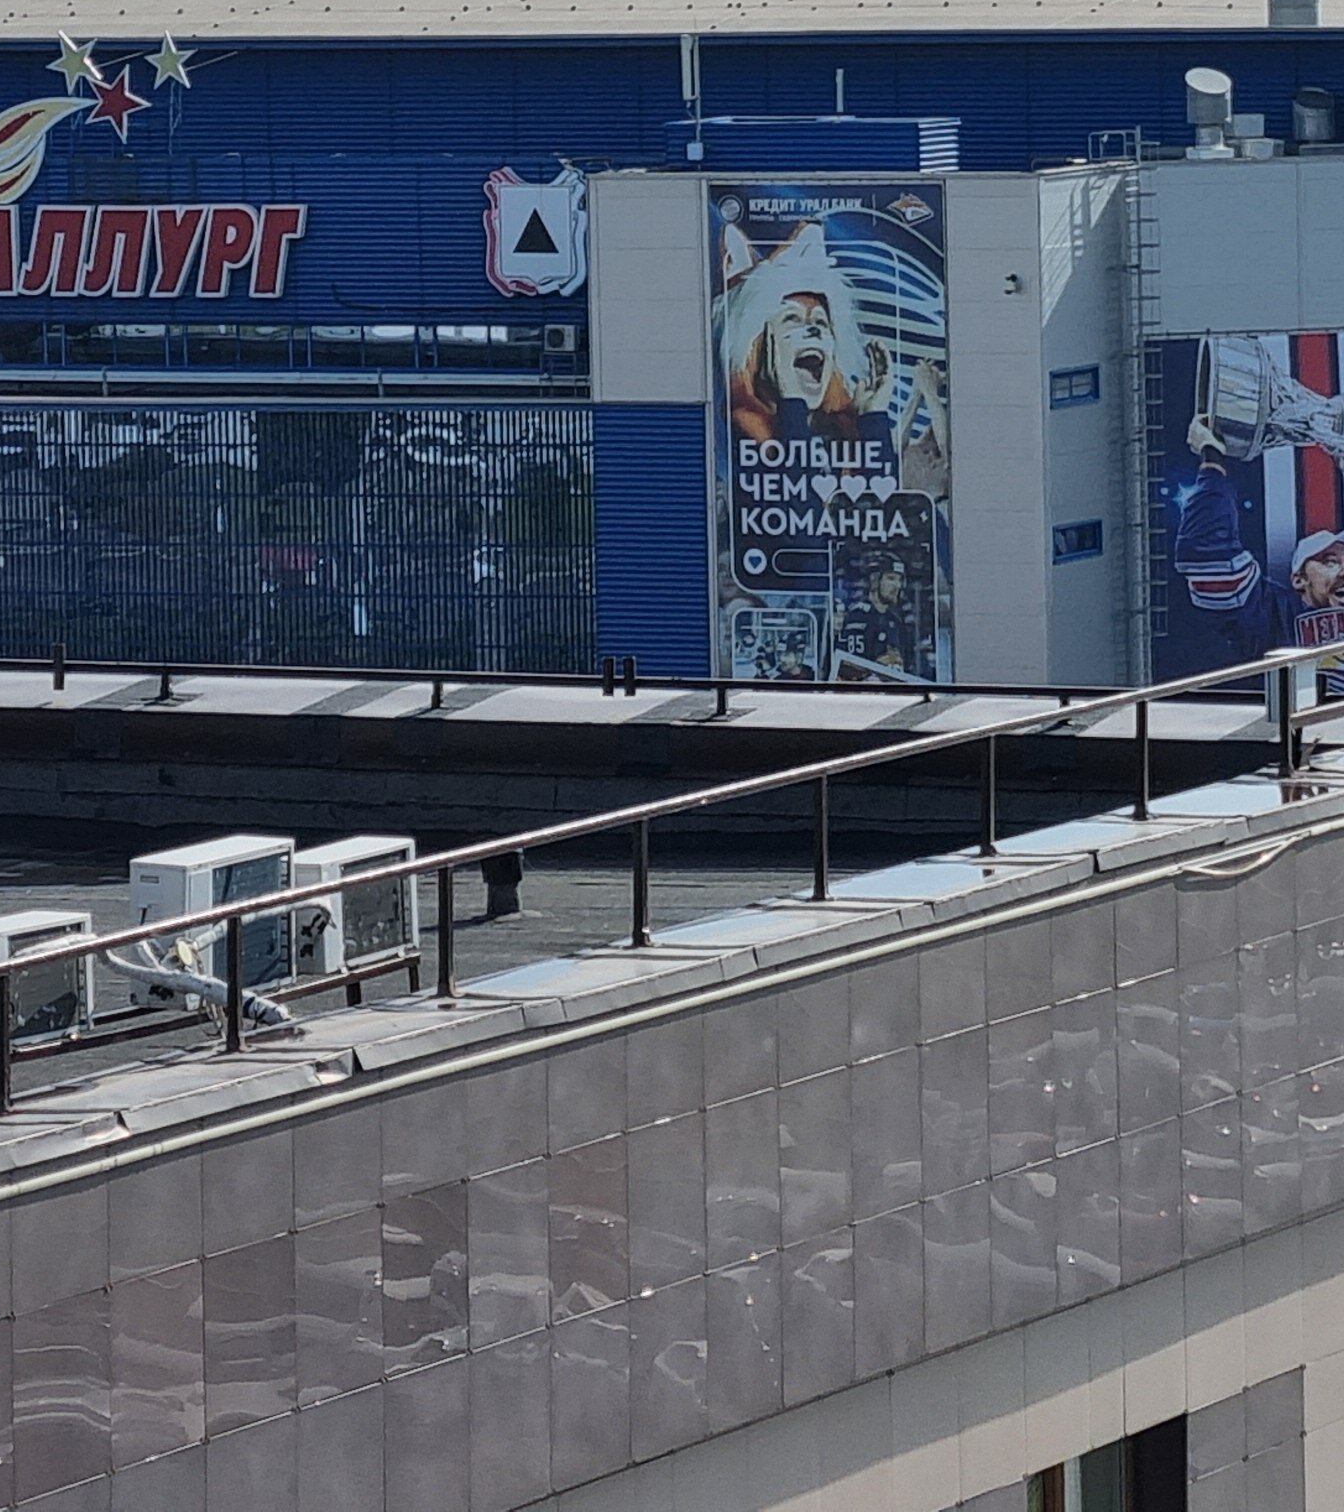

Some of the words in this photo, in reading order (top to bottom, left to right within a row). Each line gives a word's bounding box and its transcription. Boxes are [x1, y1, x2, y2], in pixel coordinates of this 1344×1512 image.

[749, 199, 796, 214] КРЕДИТ
[799, 198, 828, 212] УРАЛ
[739, 438, 892, 475] БОЛЬШЕ,
[739, 473, 807, 502] ЧЕМ
[741, 507, 909, 542] КОМАНДА
[847, 635, 865, 653] 85
